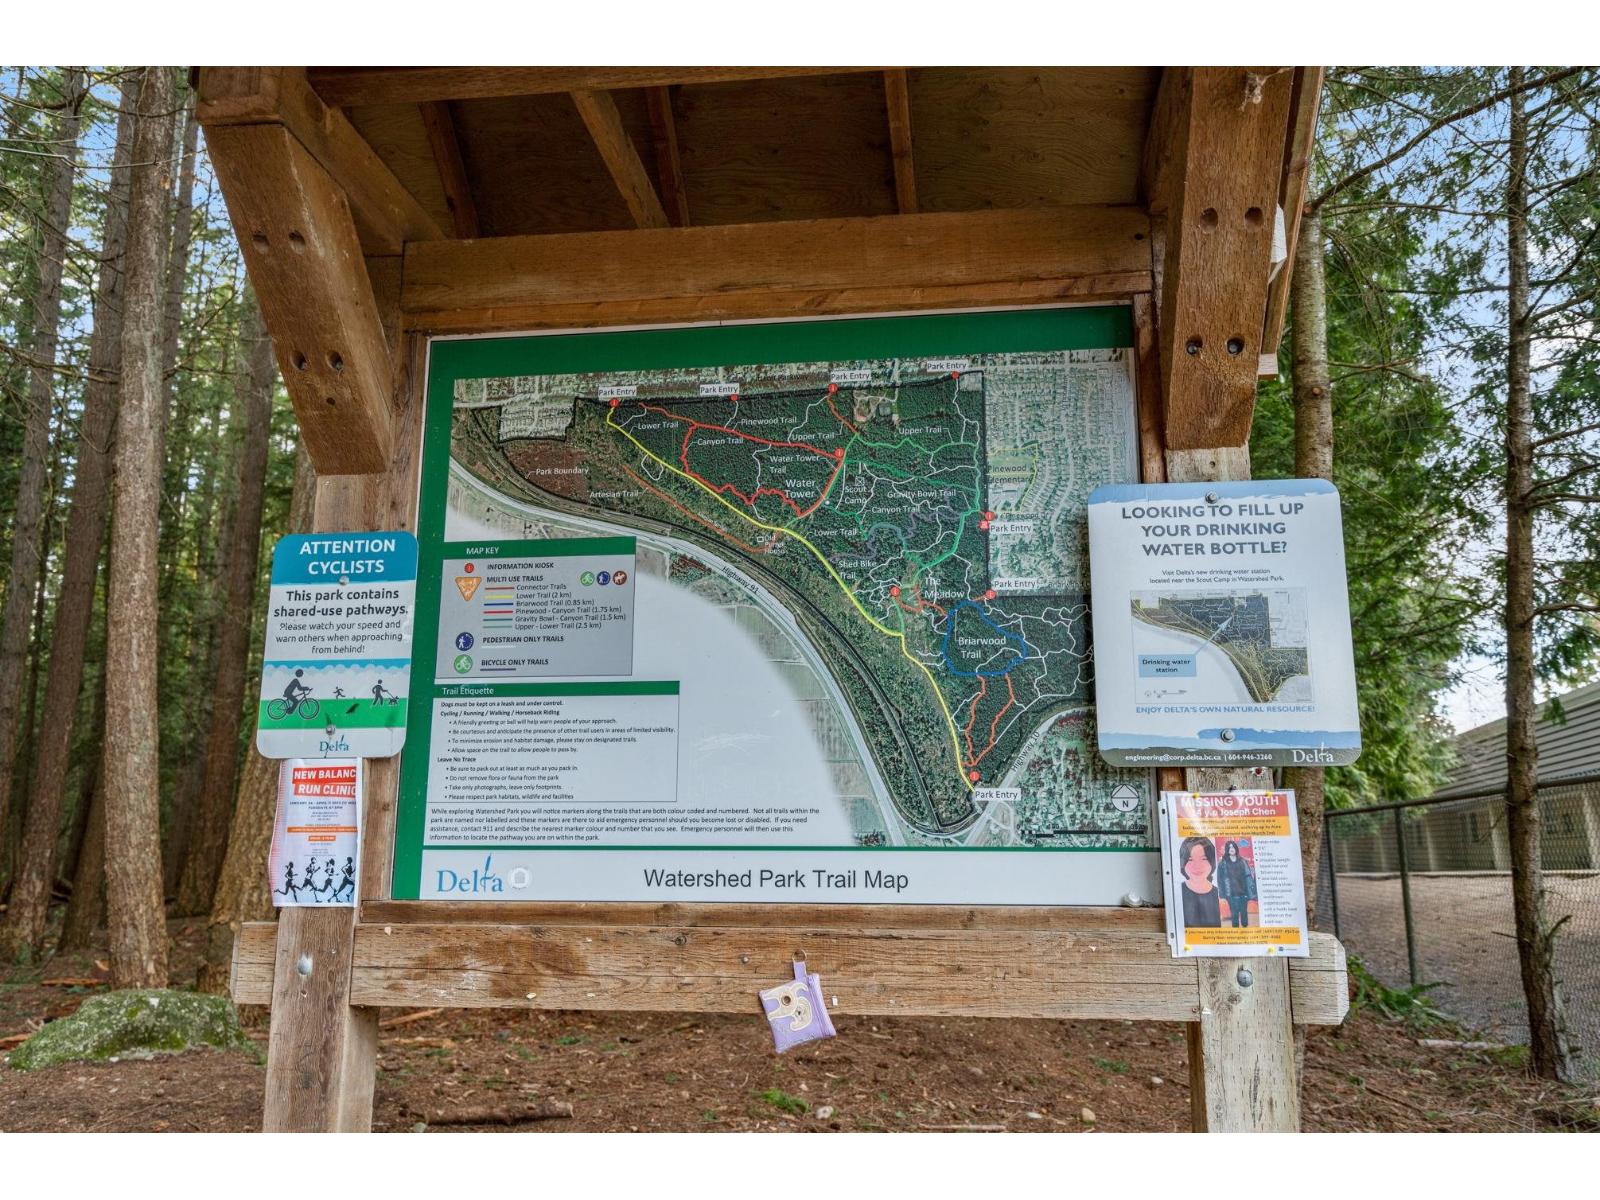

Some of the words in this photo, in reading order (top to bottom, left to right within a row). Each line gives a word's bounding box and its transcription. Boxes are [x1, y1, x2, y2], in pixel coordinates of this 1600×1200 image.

[1122, 506, 1205, 519] LOOKING
[1207, 505, 1232, 516] TO
[1239, 504, 1274, 516] FILL
[1280, 503, 1304, 515] UP
[1141, 525, 1191, 537] YOUR
[1196, 522, 1286, 536] DRINKING
[300, 539, 396, 555] ATTENTION
[1142, 544, 1206, 556] WATER
[1211, 542, 1287, 554] BOTTLE?
[308, 560, 385, 575] CYCLISTS
[722, 566, 749, 589] Highway
[749, 582, 759, 594] 91
[286, 591, 311, 601] This
[315, 590, 343, 603] park
[347, 588, 399, 600] contains
[273, 606, 343, 617] shared-use
[346, 604, 408, 616] pathways.
[280, 622, 307, 631] Please
[309, 622, 334, 630] watch
[336, 622, 356, 630] your
[357, 620, 383, 629] speed
[386, 620, 401, 629] and
[298, 634, 325, 642] others
[327, 633, 349, 642] when
[351, 632, 403, 642] approaching
[958, 637, 1006, 645] Briarwood
[334, 645, 365, 653] behind!
[460, 686, 494, 695] Etiquette
[319, 735, 349, 752] Delta
[1011, 745, 1035, 772] Highway
[1030, 732, 1040, 743] 10
[1293, 742, 1334, 763] Delta
[294, 770, 316, 780] NEW
[298, 785, 320, 794] RUN
[996, 791, 1018, 800] Entry
[1181, 797, 1233, 807] MISSING
[1236, 796, 1279, 806] YOUTH
[1220, 808, 1251, 817] Joseph
[436, 853, 504, 893] Delta
[644, 868, 752, 888] Watershed
[760, 869, 806, 888] Park
[812, 869, 856, 888] Trail
[864, 870, 909, 891] Map
